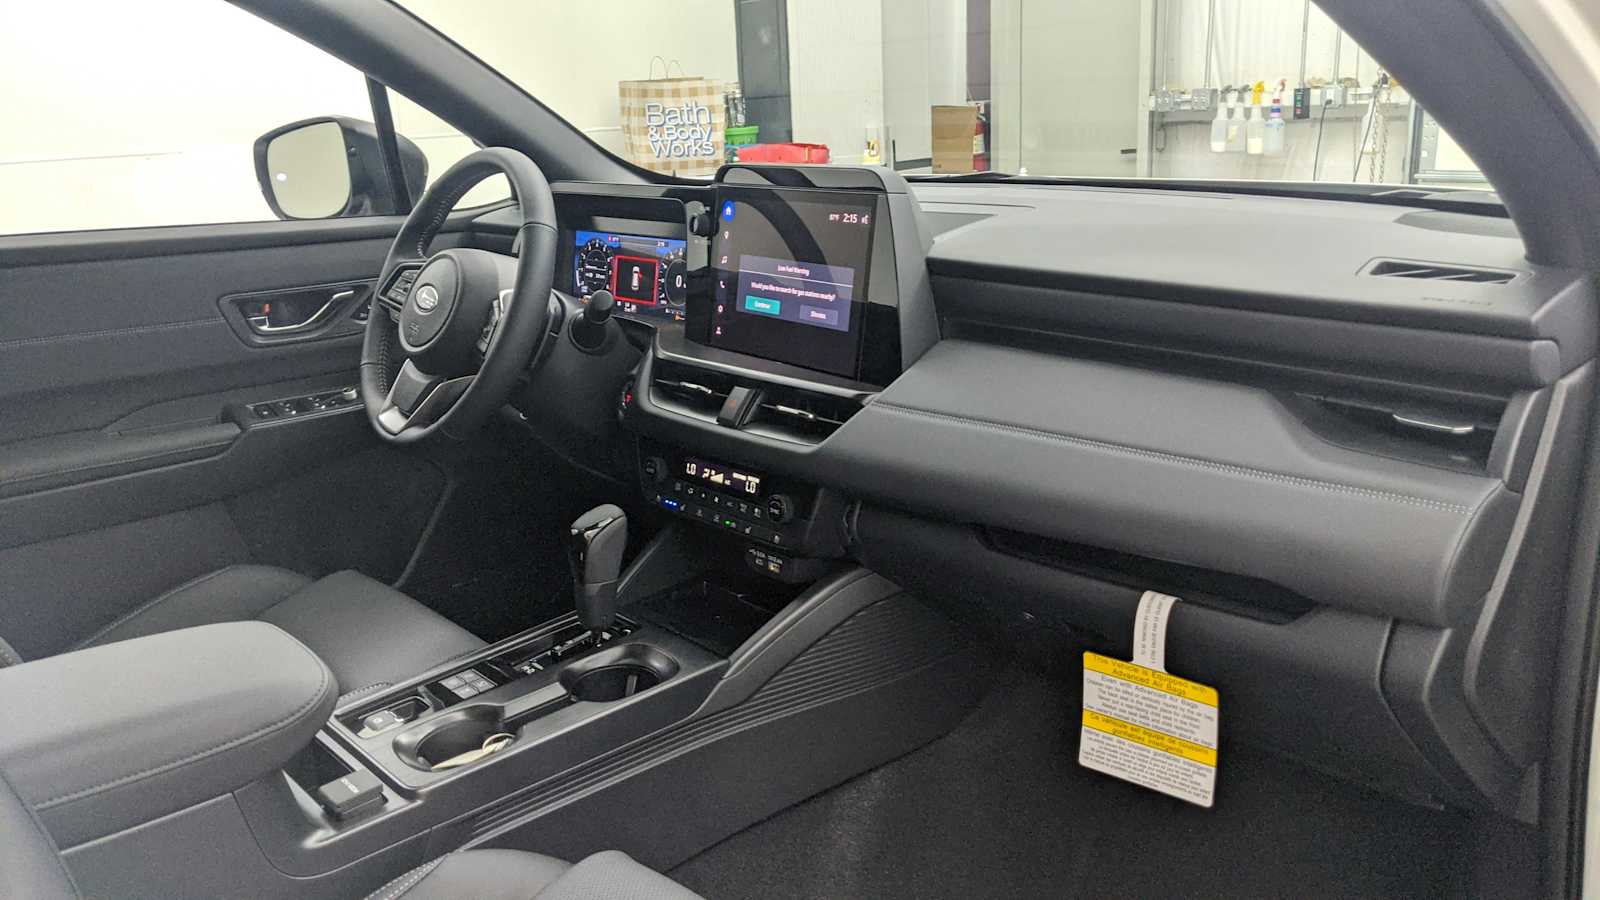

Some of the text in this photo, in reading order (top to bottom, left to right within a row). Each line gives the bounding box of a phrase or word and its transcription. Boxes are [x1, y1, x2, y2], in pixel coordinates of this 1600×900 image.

[645, 101, 711, 126] Bath
[648, 125, 711, 142] & Body
[649, 141, 715, 158] Works
[843, 212, 858, 223] 2:15
[676, 274, 682, 288] 0
